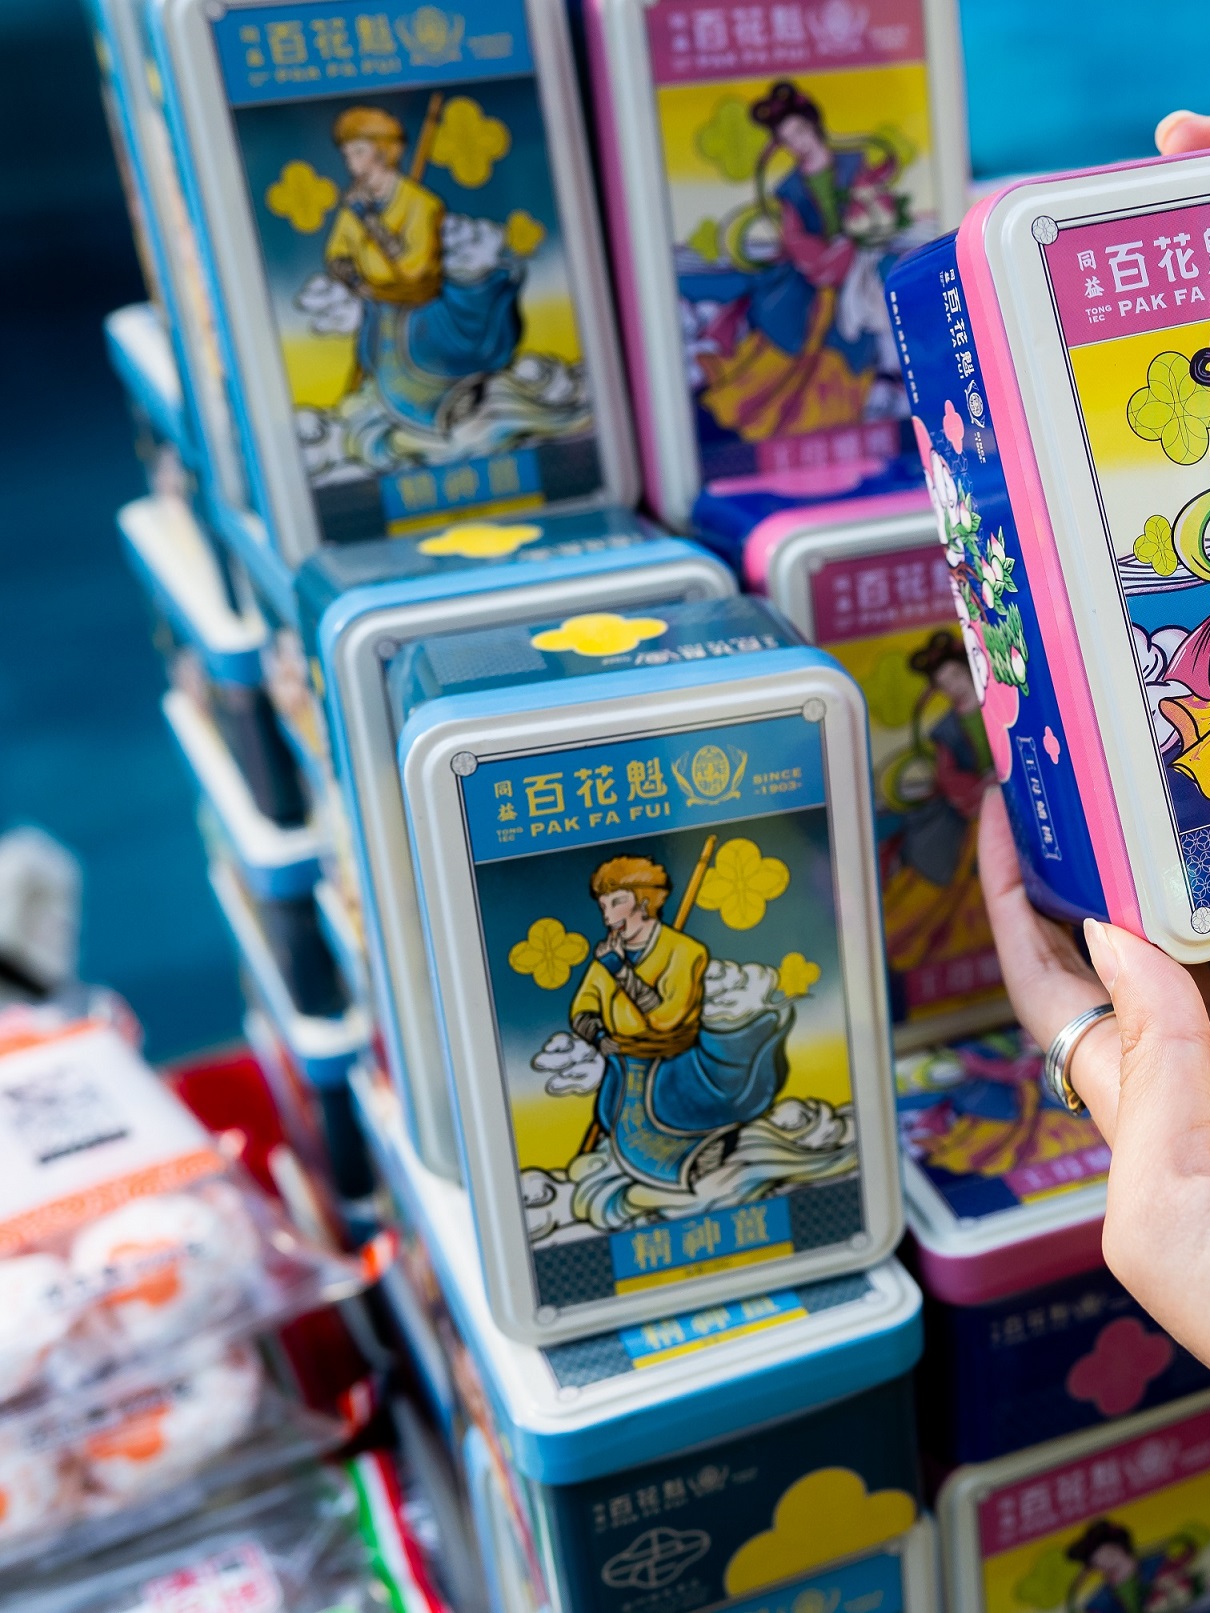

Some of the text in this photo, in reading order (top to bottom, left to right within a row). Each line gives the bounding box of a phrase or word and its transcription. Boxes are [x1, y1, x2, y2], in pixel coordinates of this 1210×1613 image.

[1077, 249, 1105, 299] 同益
[1085, 304, 1112, 316] TONG
[1118, 293, 1167, 317] PAK
[1174, 286, 1205, 306] FA
[1089, 314, 1106, 324] IEC
[523, 757, 668, 817] 百花魁
[753, 768, 802, 786] SINCE
[531, 801, 671, 837] PAK FA FUI
